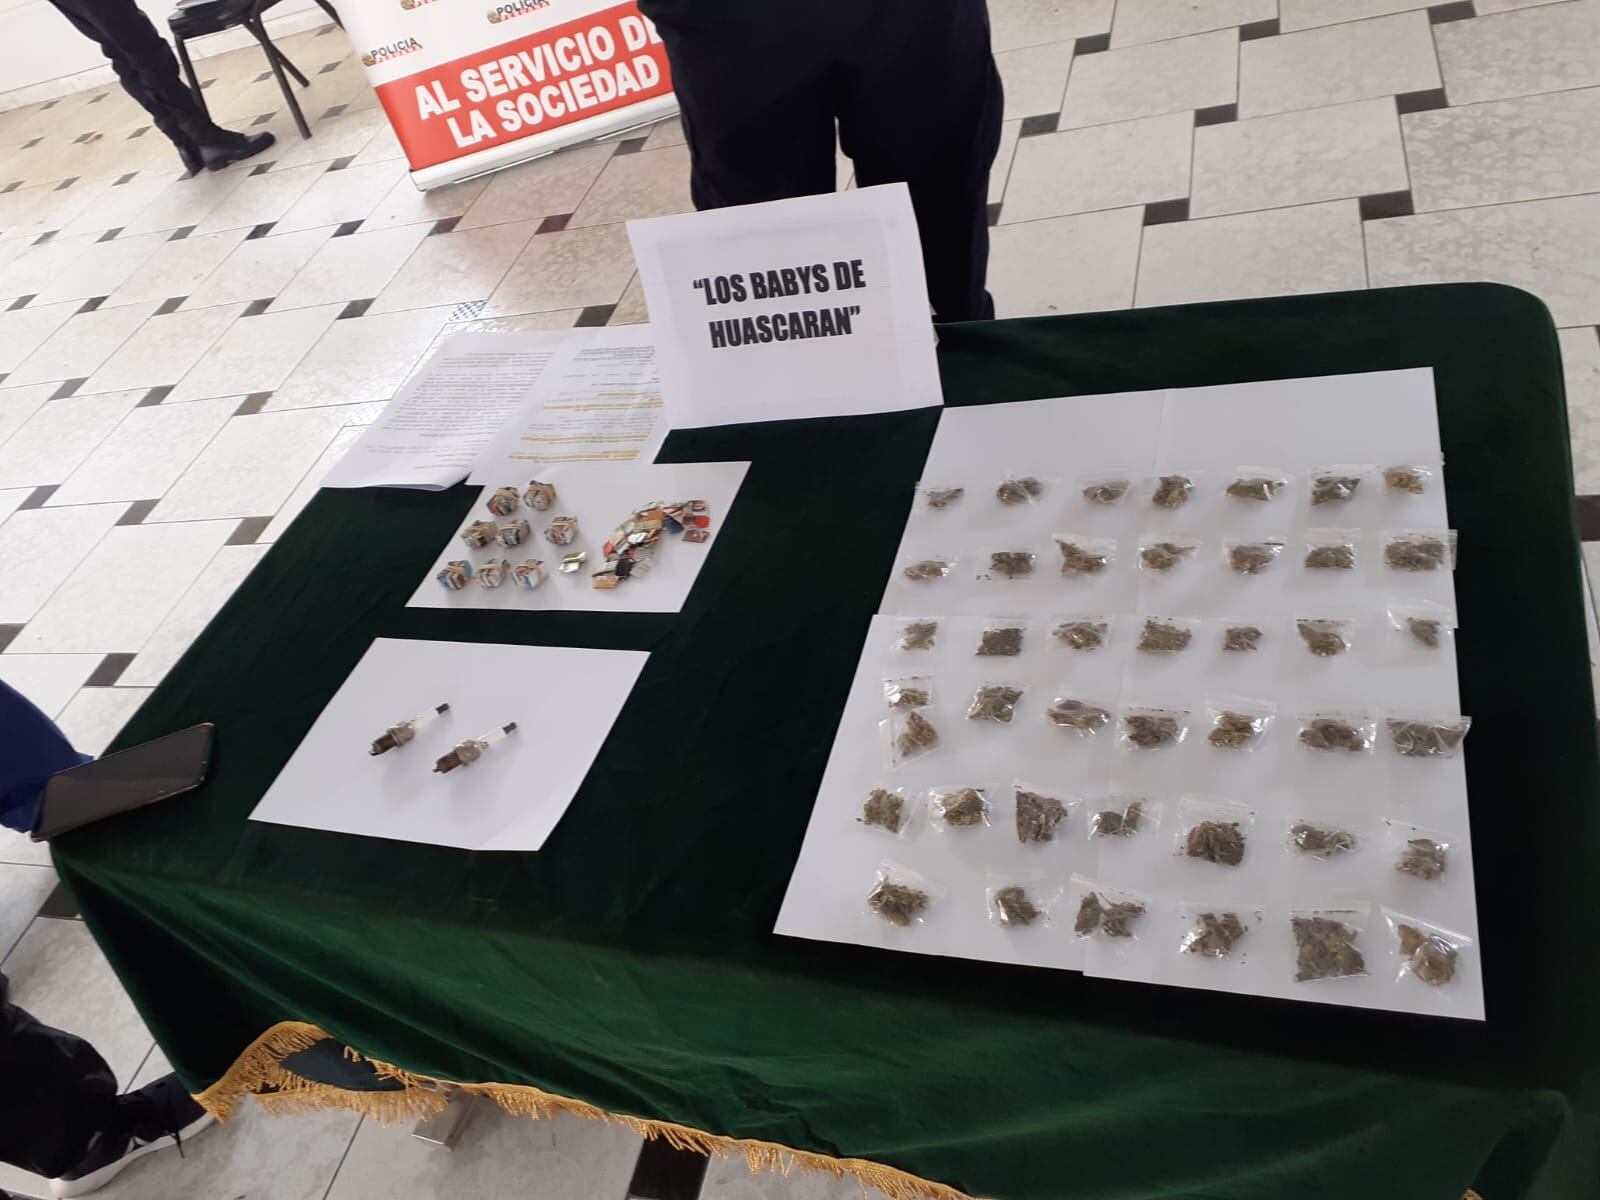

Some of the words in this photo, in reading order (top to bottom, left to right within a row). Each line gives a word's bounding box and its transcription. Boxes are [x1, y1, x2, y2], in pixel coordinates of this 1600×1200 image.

[371, 37, 418, 59] POLICIA
[414, 80, 460, 120] AL
[460, 25, 616, 103] SERVICIO
[447, 109, 498, 148] LA
[496, 55, 660, 133] SOCIEDAD
[693, 273, 748, 306] “LOS
[750, 263, 830, 300] BABYS
[833, 259, 866, 289] DE
[708, 305, 861, 348] HUASCARAN”
